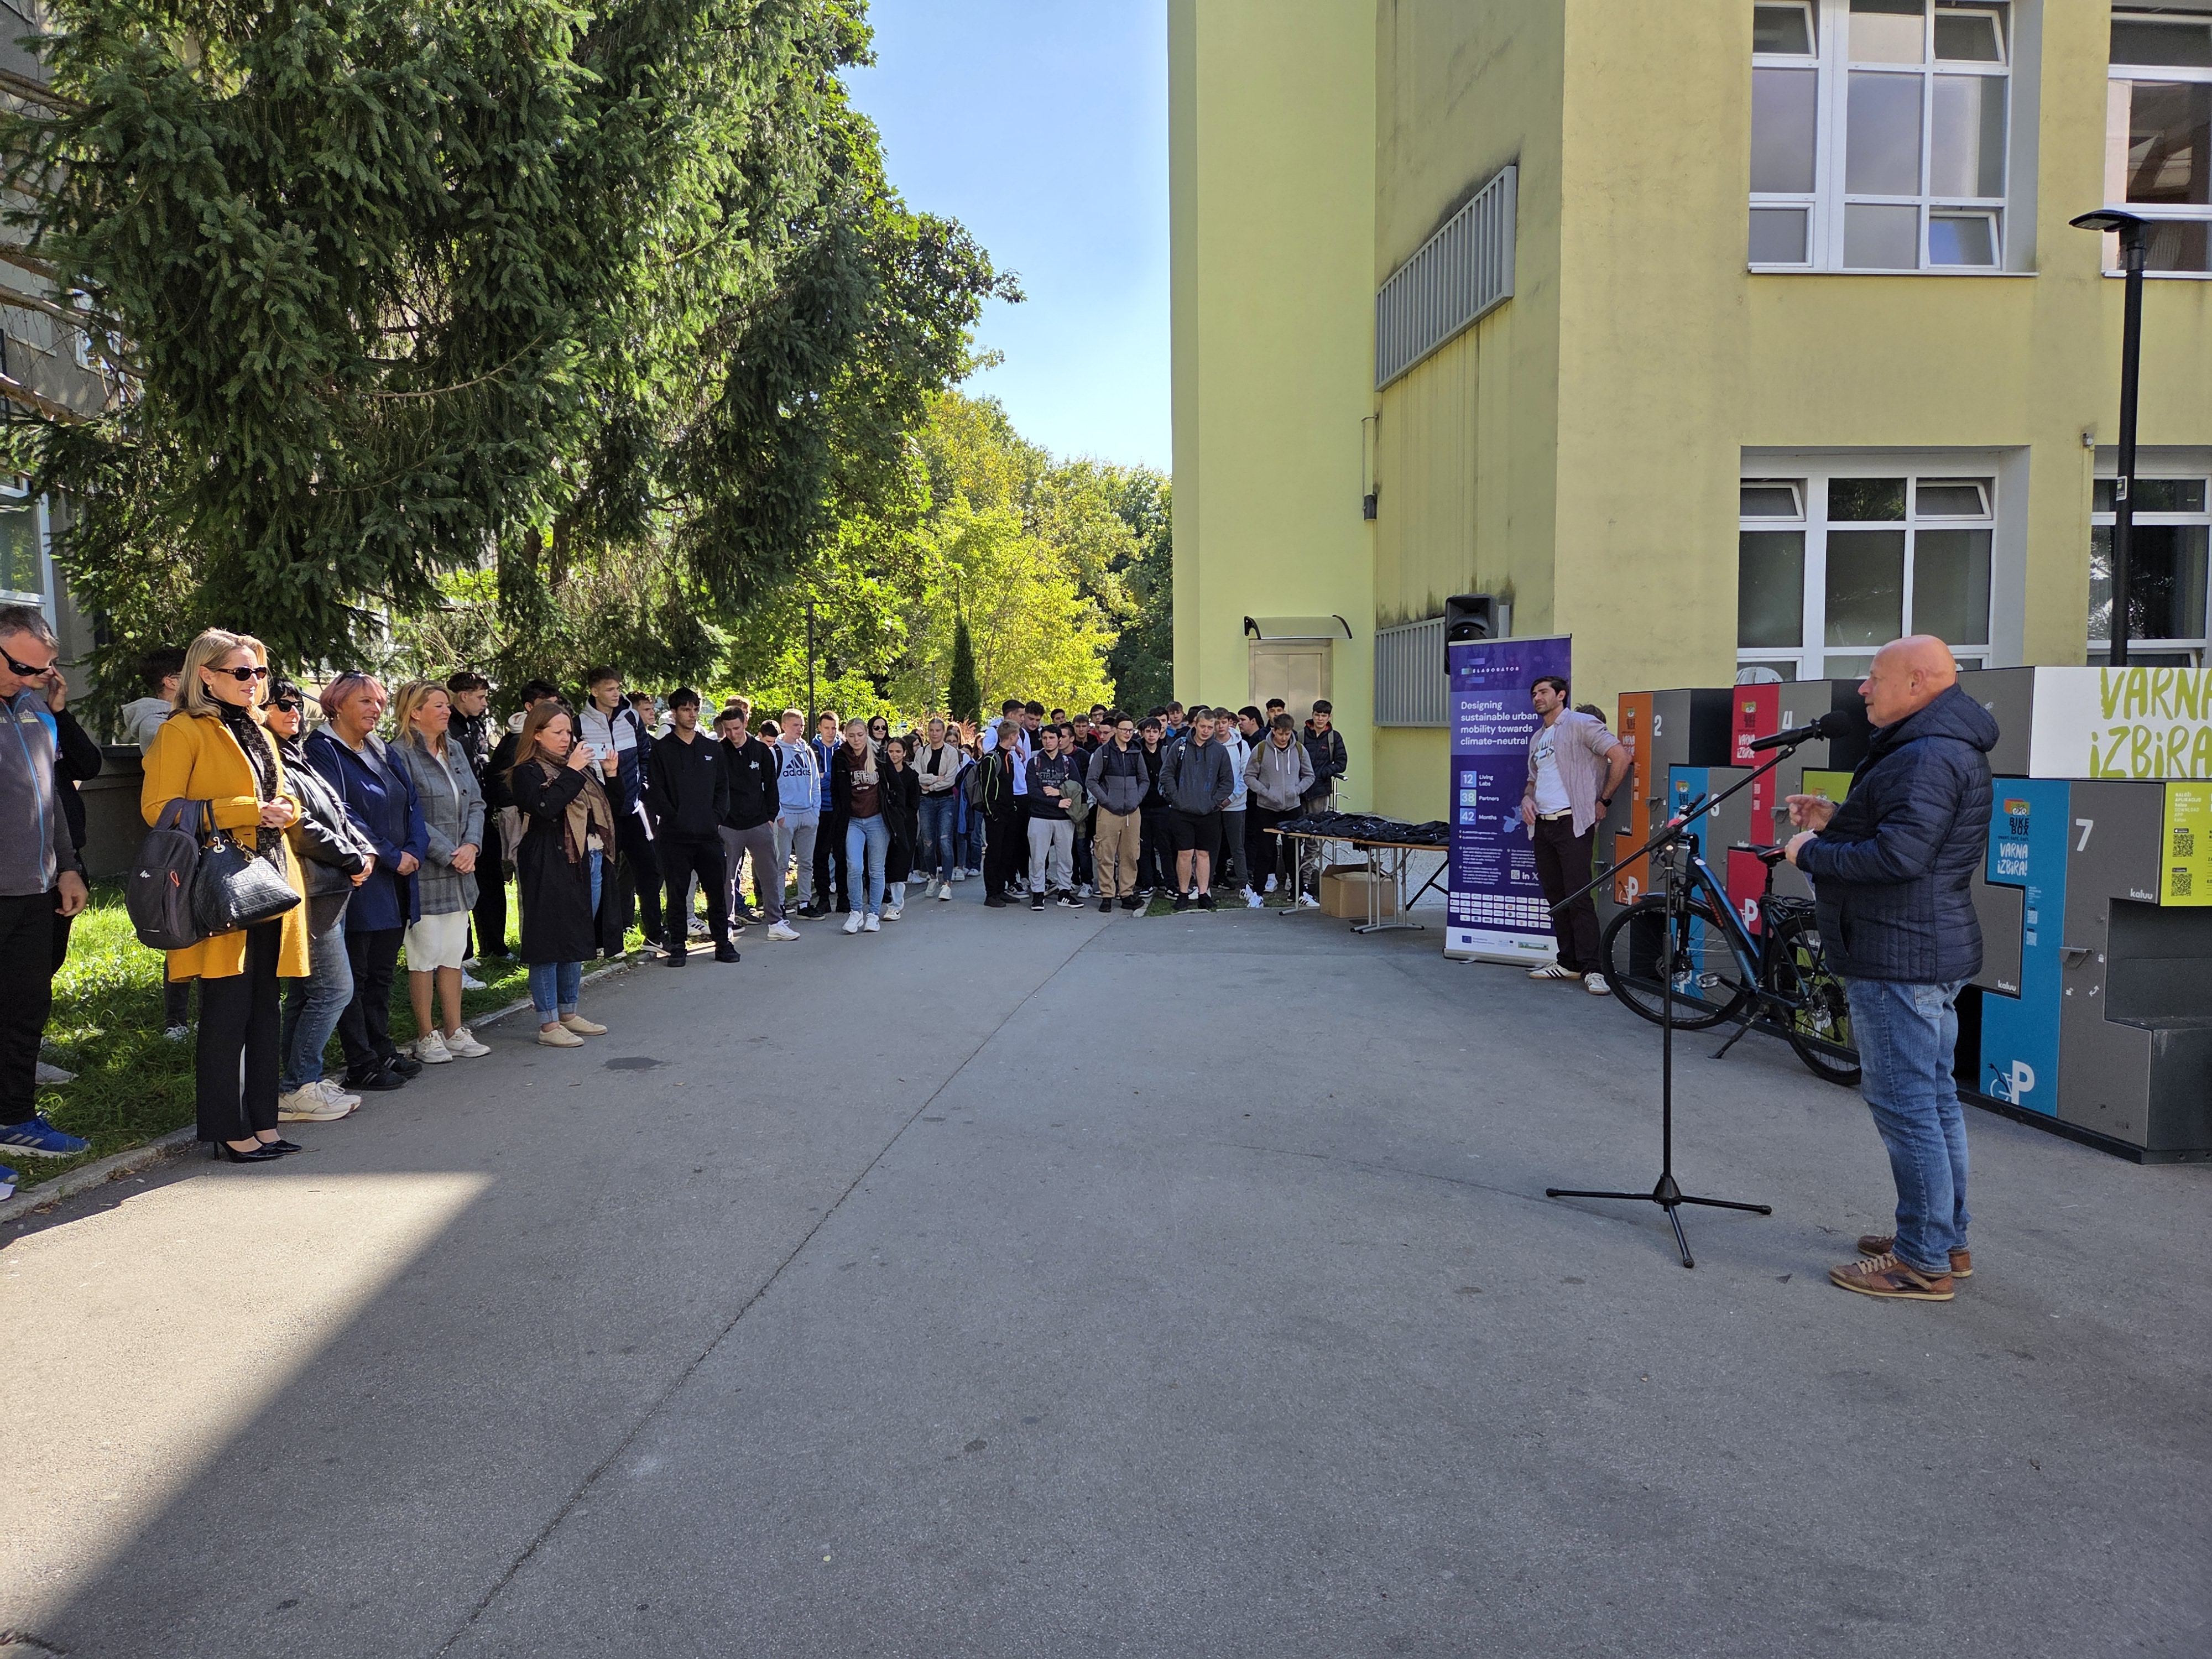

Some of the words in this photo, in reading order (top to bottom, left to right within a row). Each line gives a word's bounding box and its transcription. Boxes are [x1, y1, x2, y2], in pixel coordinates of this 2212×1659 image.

[1461, 700, 1503, 711] Designing
[1460, 712, 1510, 722] sustainable
[1512, 711, 1538, 720] urban
[1460, 724, 1496, 735] mobility
[1498, 724, 1533, 733] towards
[1654, 715, 1662, 737] 2
[1460, 736, 1528, 745] climate-neutral
[782, 768, 811, 778] addas
[1463, 774, 1473, 784] 12
[1462, 792, 1475, 802] 38
[1461, 811, 1475, 821] 42
[2010, 817, 2030, 827] BIKE
[2011, 826, 2029, 836] BOX
[2076, 818, 2093, 851] 7
[2000, 842, 2028, 859] VARNA
[1522, 872, 1530, 880] in
[1628, 876, 1639, 905] P
[2130, 888, 2153, 900] kaluu
[1744, 898, 1759, 931] P
[1997, 979, 2017, 992] kaluu
[2011, 1060, 2035, 1105] P
